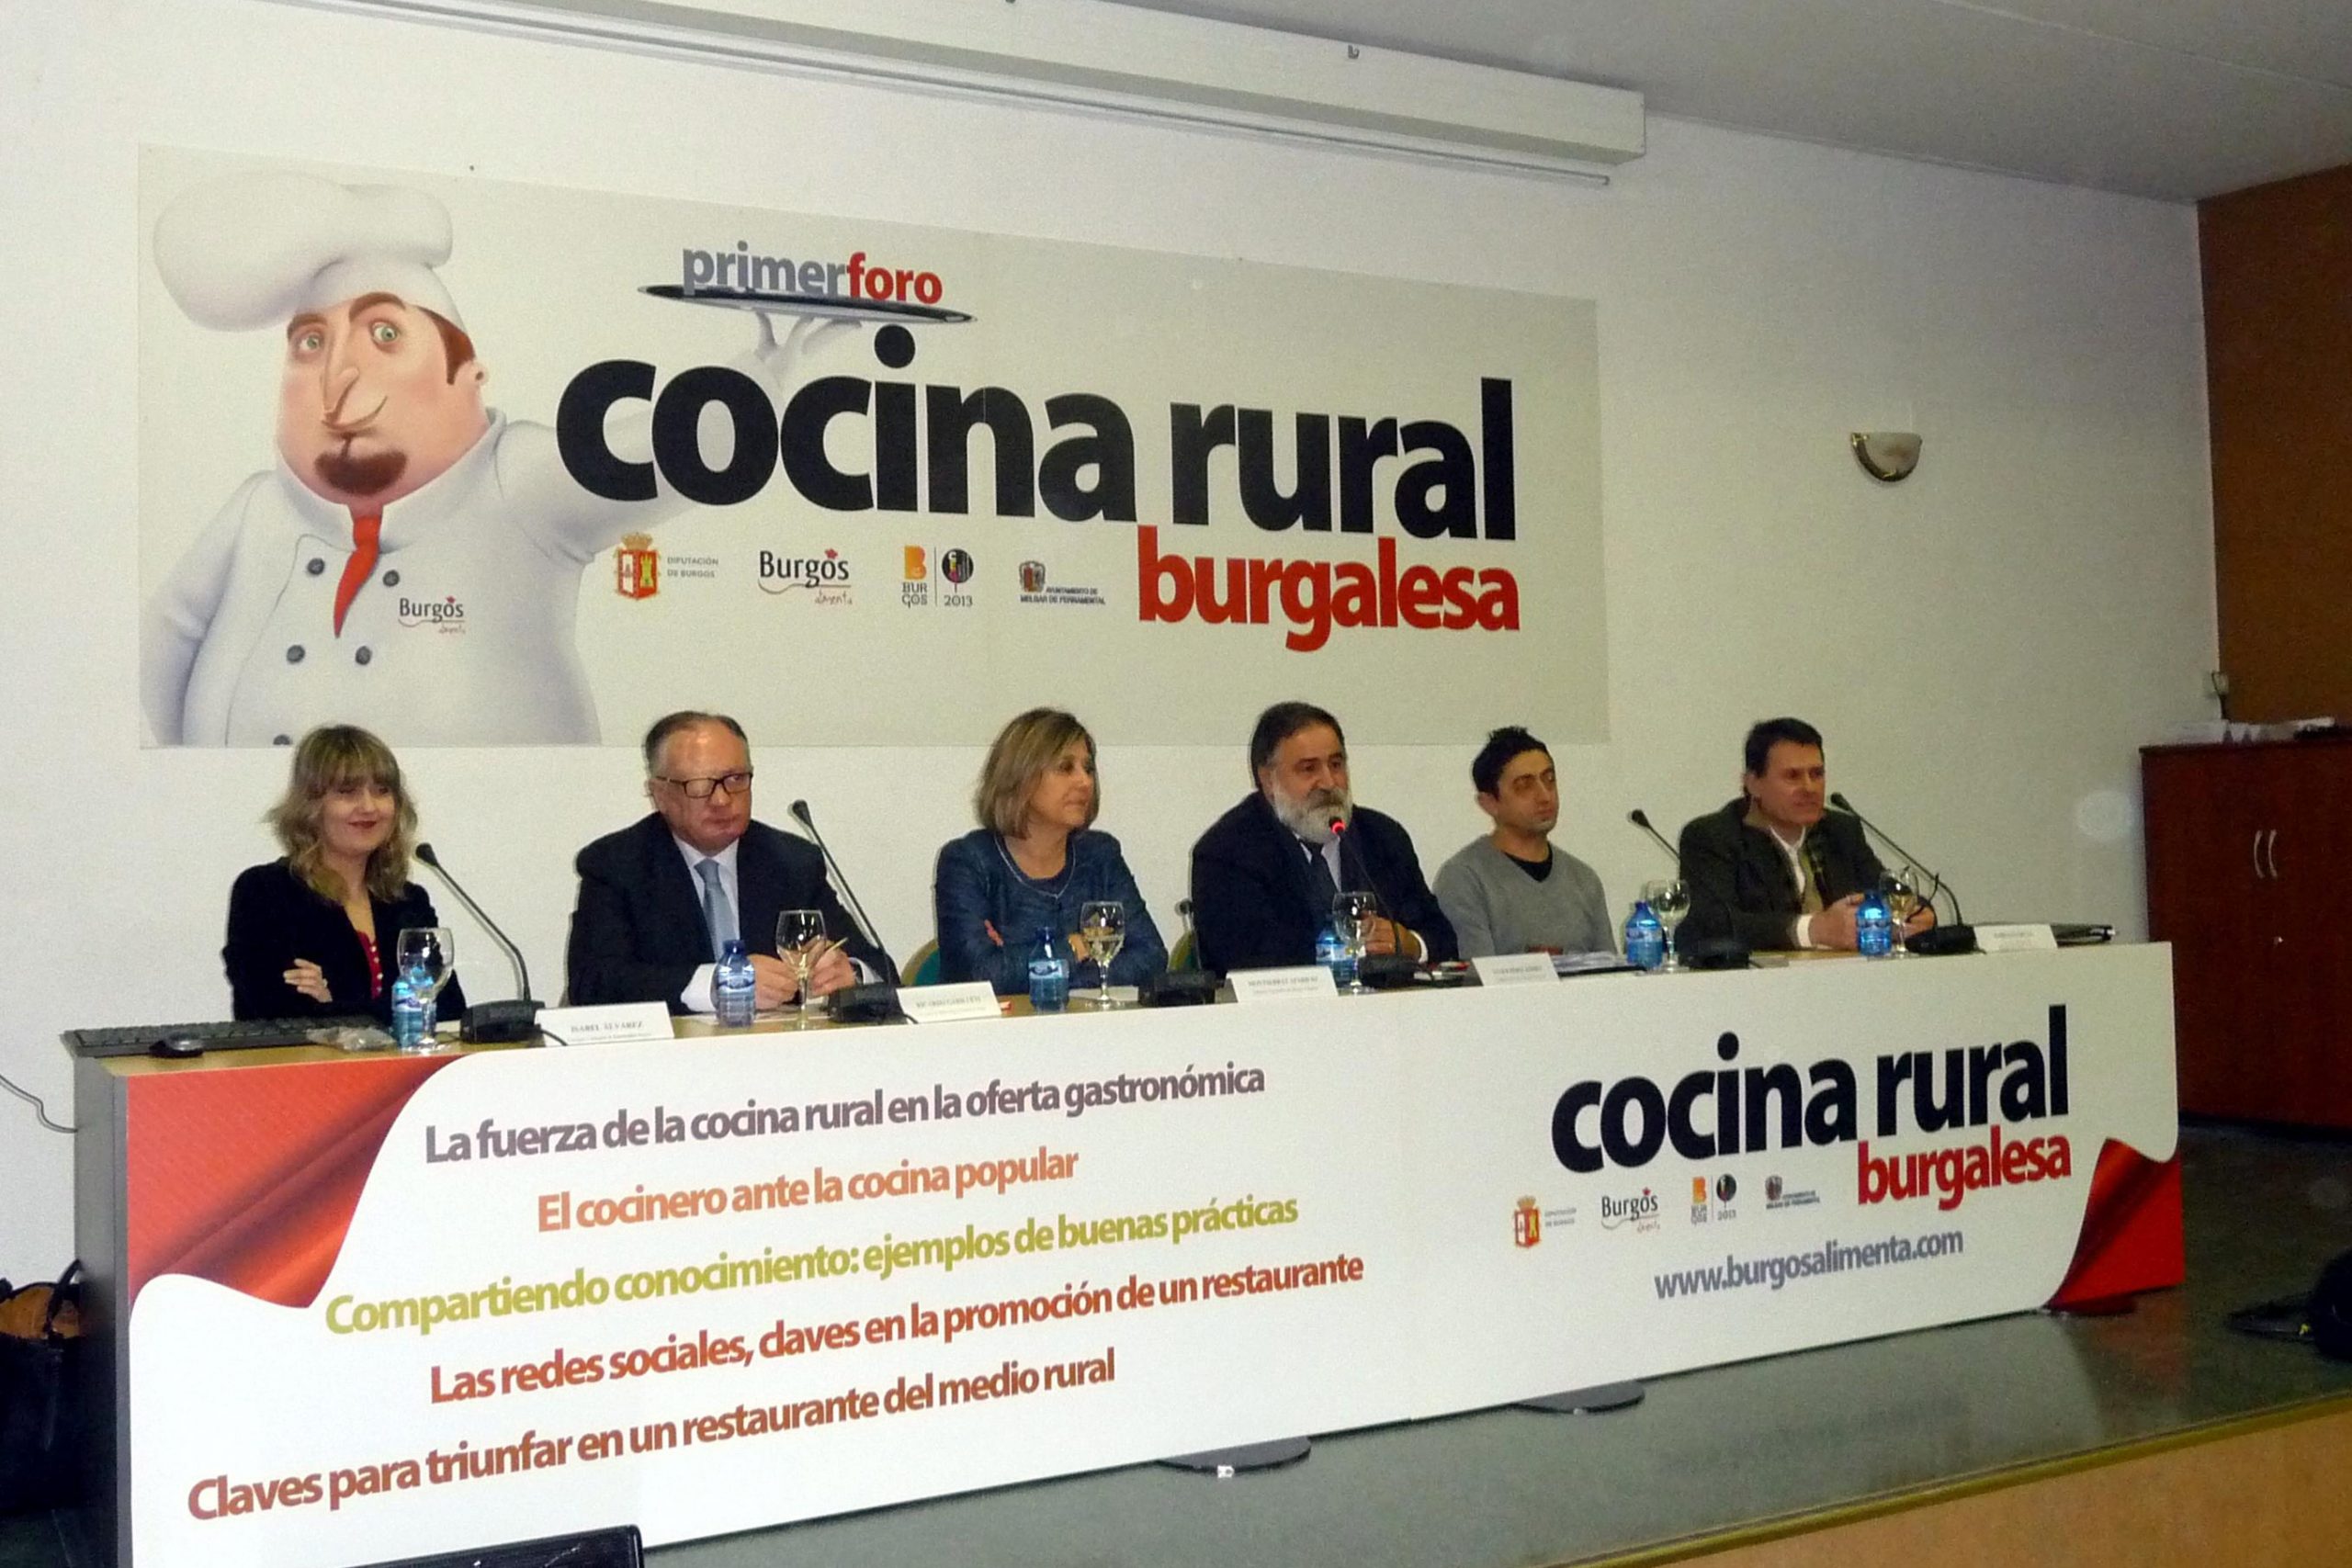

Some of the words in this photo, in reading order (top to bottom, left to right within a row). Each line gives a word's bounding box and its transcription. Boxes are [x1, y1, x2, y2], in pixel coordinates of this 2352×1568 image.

[557, 325, 1137, 523] cocina
[1170, 378, 1516, 541] rural
[400, 597, 464, 624] Burgos
[760, 550, 850, 589] Burgos
[944, 595, 974, 607] 2013
[1137, 525, 1520, 652] burgalesa
[426, 1126, 470, 1163] La
[477, 1119, 596, 1158] fuerza
[603, 1110, 650, 1147] de
[655, 1107, 684, 1143] la
[691, 1100, 799, 1140] cocina
[806, 1089, 883, 1130] rural
[888, 1096, 928, 1122] en
[934, 1084, 961, 1120] la
[967, 1079, 1059, 1116] oferta
[1065, 1061, 1265, 1117] gastronómica
[1553, 1032, 1858, 1173] cocina
[1877, 1004, 2069, 1138] rural
[539, 1191, 571, 1232] El
[577, 1185, 727, 1227] cocinero
[732, 1176, 809, 1212] ante
[815, 1168, 842, 1203] la
[848, 1159, 950, 1199] cocina
[956, 1146, 1080, 1199] popular
[1601, 1196, 1658, 1221] Burgos
[1858, 1125, 2072, 1212] burgalesa
[326, 1269, 609, 1335] Compartiendo
[615, 1246, 859, 1301] conocimiento:
[864, 1224, 1011, 1280] ejemplos
[1014, 1218, 1054, 1254] de
[1058, 1213, 1168, 1248] buenas
[1172, 1194, 1299, 1245] prácticas
[1655, 1230, 1964, 1299] www.burgosalimenta.com
[432, 1366, 495, 1404] Las
[502, 1348, 605, 1394] redes
[610, 1330, 753, 1379] sociales,
[759, 1320, 860, 1358] claves
[865, 1315, 905, 1344] en
[911, 1303, 939, 1337] la
[944, 1281, 1113, 1343] promoción
[1117, 1274, 1155, 1310] de
[1159, 1278, 1198, 1305] un
[1203, 1254, 1363, 1300] restaurante
[188, 1474, 322, 1519] Claves
[330, 1461, 420, 1510] para
[425, 1429, 572, 1484] triunfar
[578, 1430, 623, 1461] en
[630, 1422, 676, 1453] un
[684, 1389, 879, 1445] restaurante
[884, 1372, 933, 1414] del
[939, 1360, 1039, 1405] medio
[1045, 1347, 1115, 1390] rural
